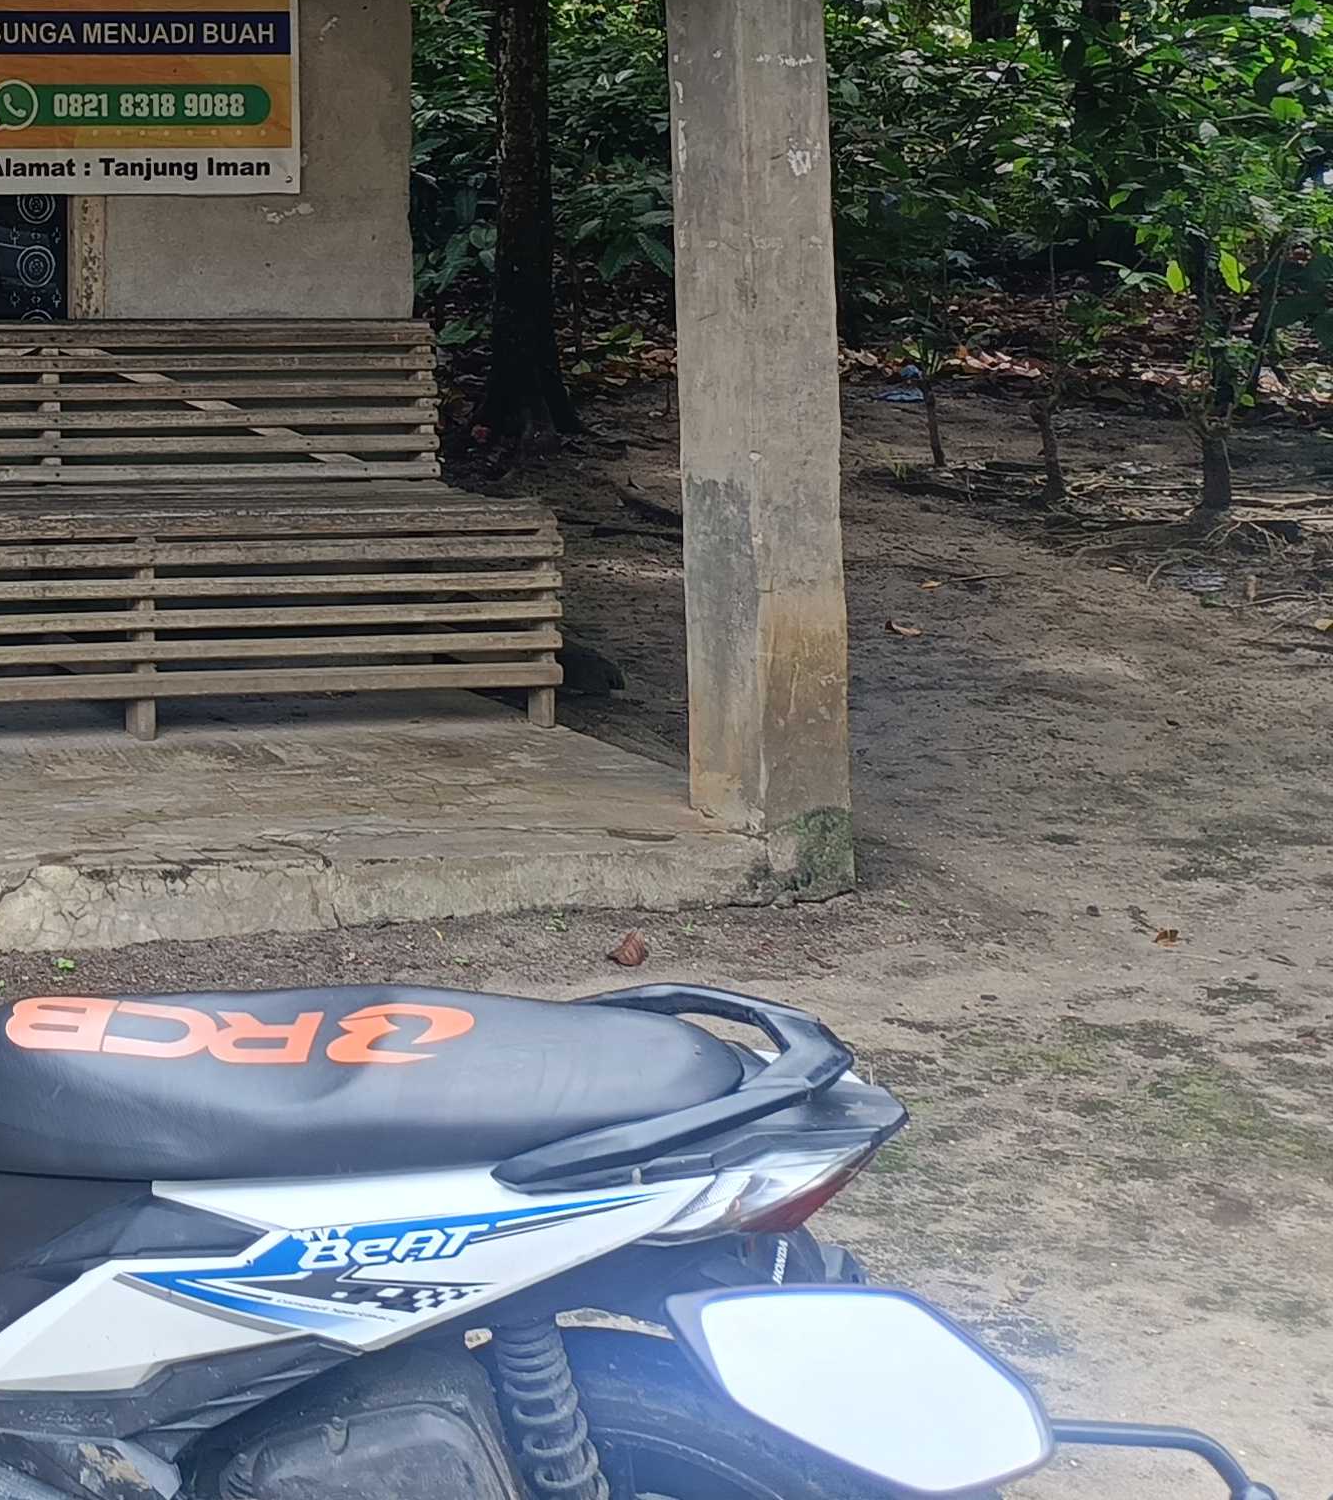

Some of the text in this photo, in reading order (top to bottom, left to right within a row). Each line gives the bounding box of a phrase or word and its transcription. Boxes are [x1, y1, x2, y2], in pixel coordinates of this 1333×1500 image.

[83, 22, 195, 44] MENJADI
[203, 22, 275, 44] BUAH
[53, 93, 245, 117] 0821 8318 9088
[84, 161, 91, 176] :
[99, 158, 198, 181] Tanjung
[207, 158, 271, 176] Iman
[772, 1239, 789, 1287] HONDA
